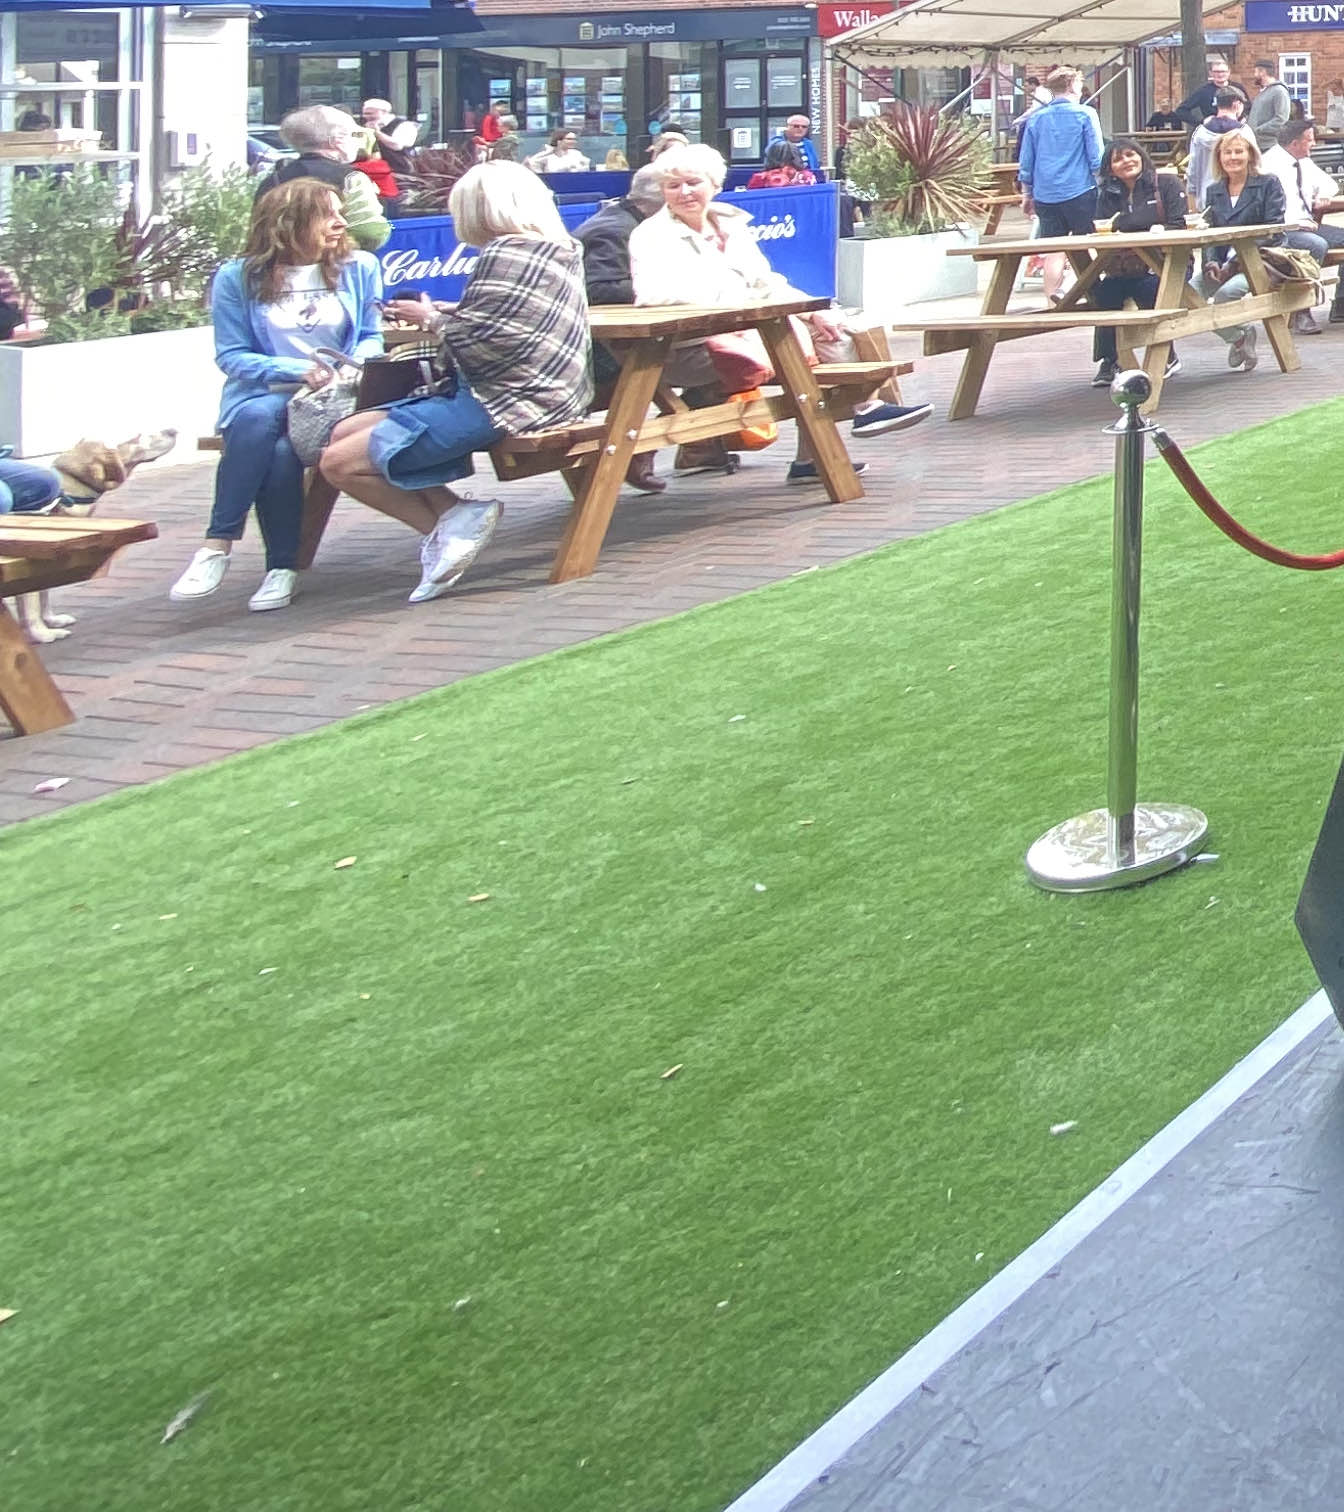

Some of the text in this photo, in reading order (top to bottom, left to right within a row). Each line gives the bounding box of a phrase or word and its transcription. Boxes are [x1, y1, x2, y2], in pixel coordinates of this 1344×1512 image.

[833, 10, 881, 28] Walla
[597, 22, 675, 39] John Shepherd
[811, 108, 821, 134] NEW
[381, 242, 479, 286] Carlu
